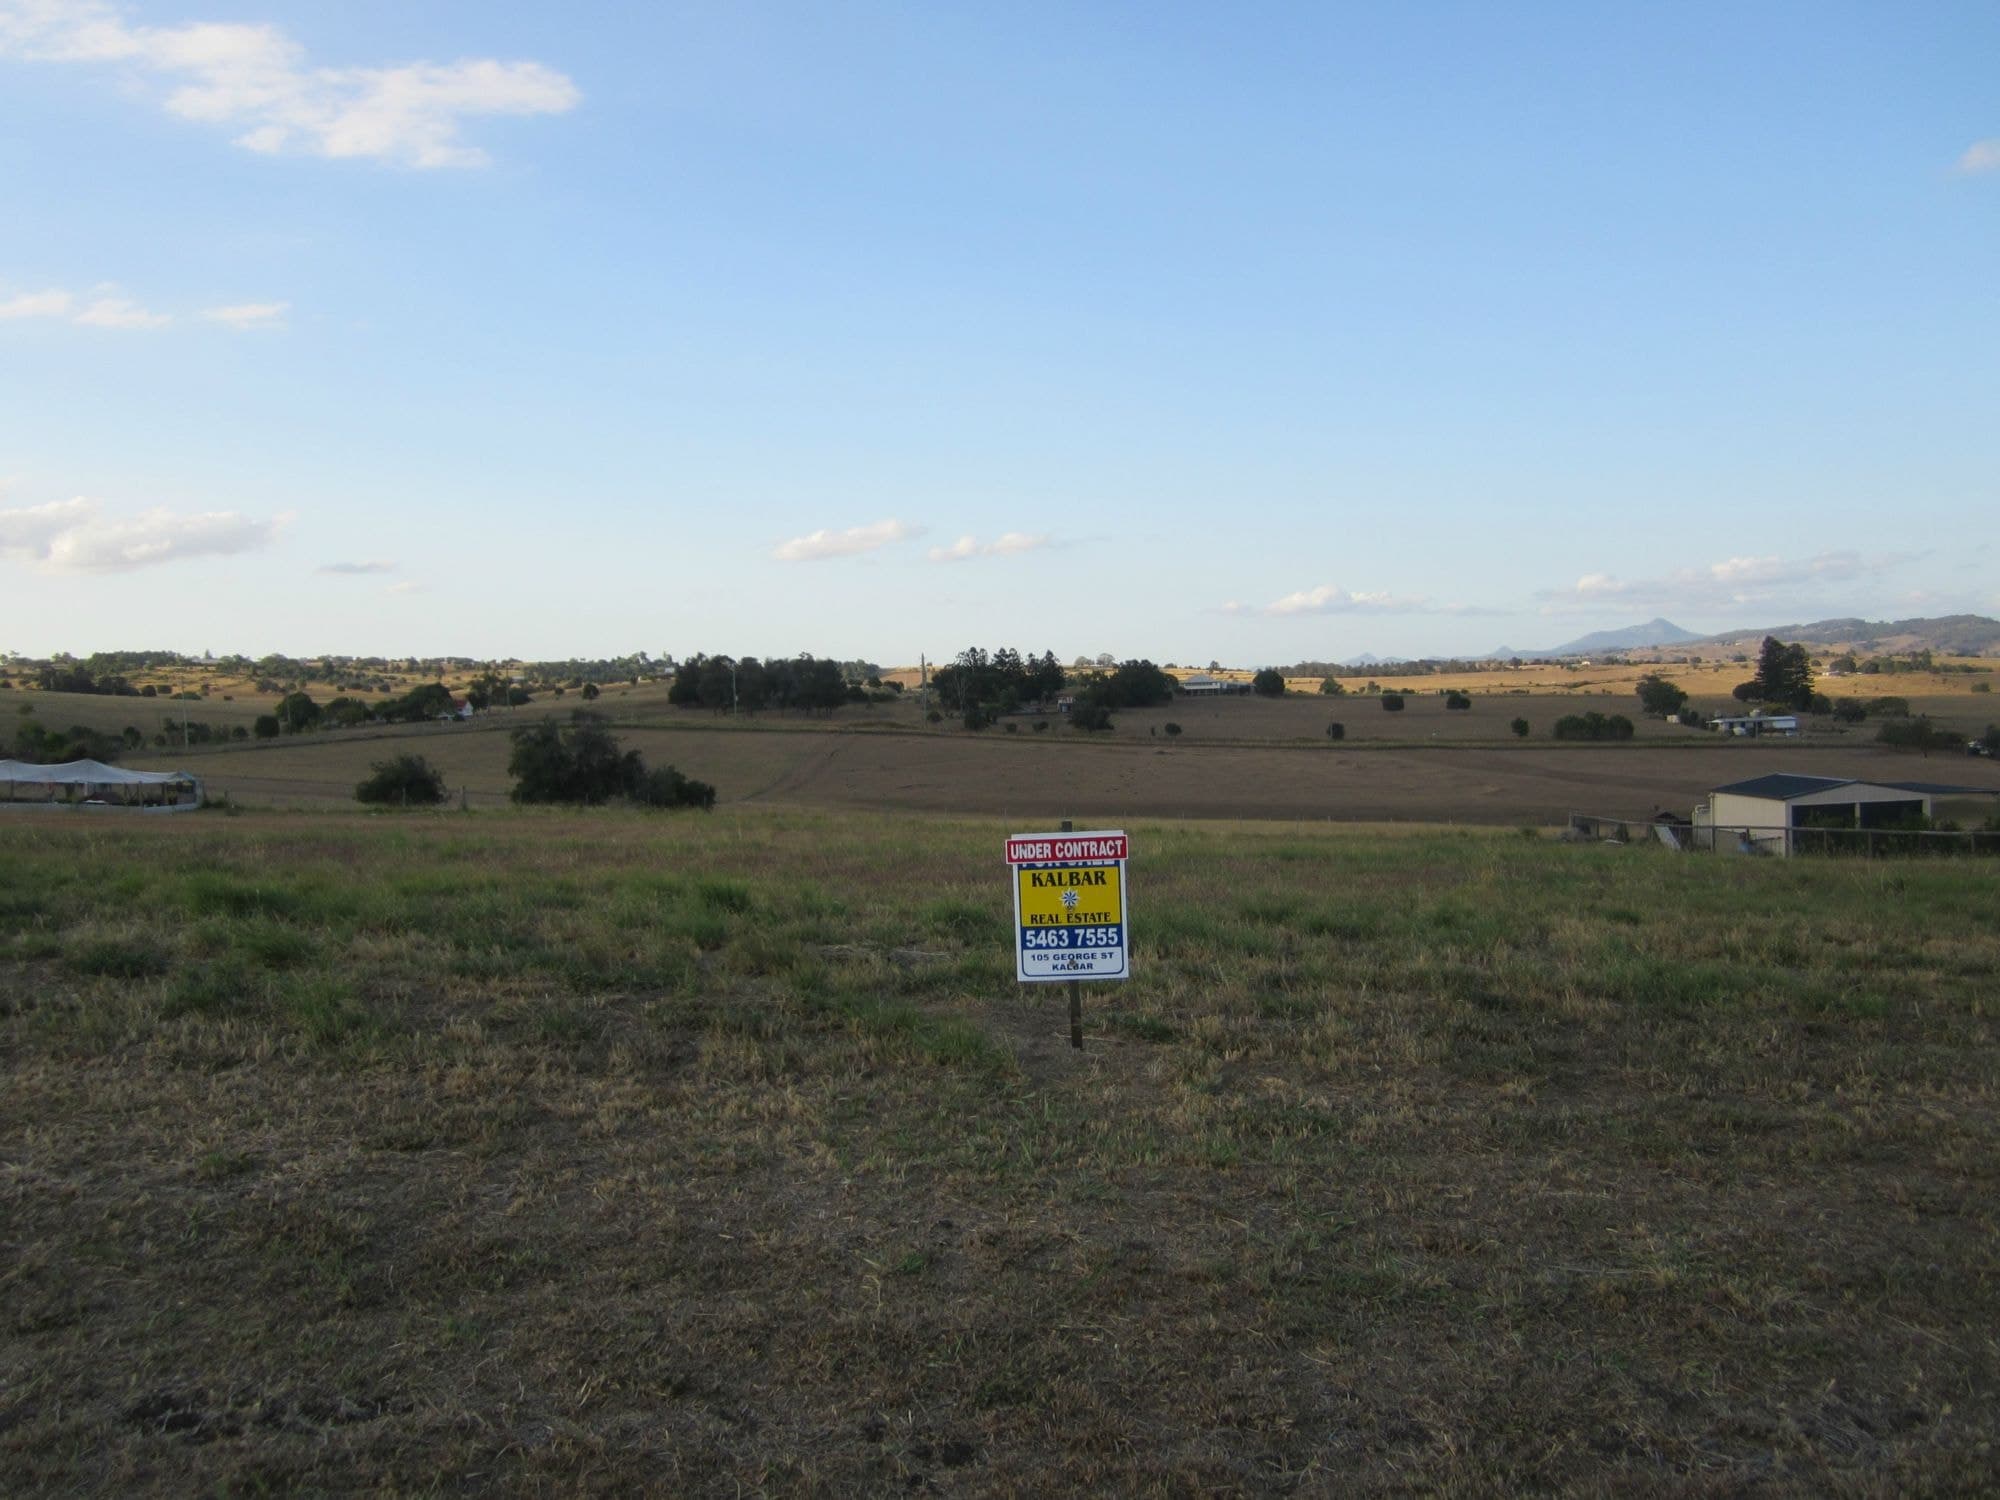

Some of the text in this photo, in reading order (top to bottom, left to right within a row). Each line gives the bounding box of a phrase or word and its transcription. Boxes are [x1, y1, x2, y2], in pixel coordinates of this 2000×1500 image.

[1010, 840, 1123, 860] UNDER CONTRACT
[1032, 871, 1106, 887] KALBAR
[1030, 912, 1111, 924] REAL ESTATE
[1026, 928, 1118, 948] 5463 7555
[1053, 952, 1097, 960] GEORGE
